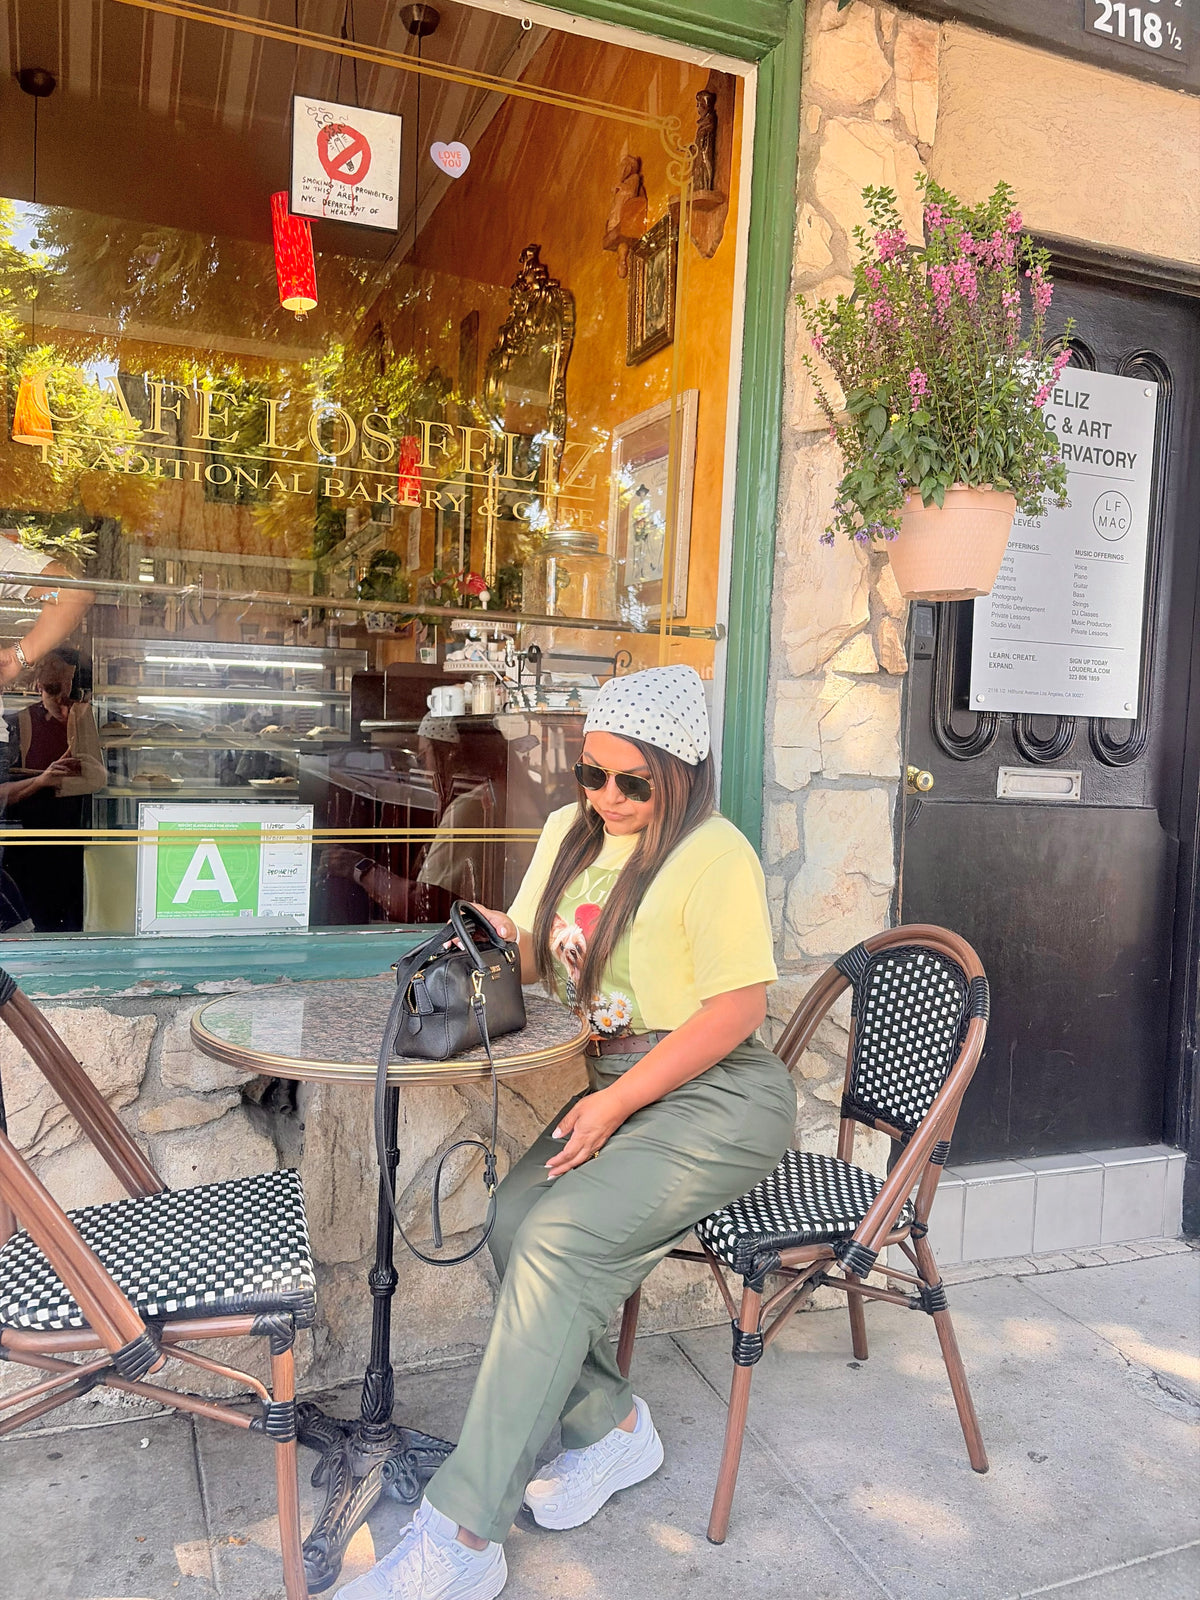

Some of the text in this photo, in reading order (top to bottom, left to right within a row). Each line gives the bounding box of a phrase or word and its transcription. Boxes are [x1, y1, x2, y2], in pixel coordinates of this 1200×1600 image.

[1093, 0, 1163, 48] 2118
[438, 150, 462, 160] LOVE
[442, 159, 462, 168] YOU
[302, 176, 394, 202] SMOKING IS PROHIBITED
[313, 186, 331, 195] THIS
[336, 191, 359, 202] AREA
[301, 194, 380, 215] NYC DEPARTMENT OF
[330, 207, 359, 217] HEALTH
[1050, 387, 1091, 410] ELIZ
[30, 366, 598, 491] CAFE LOS FELIZ
[1061, 416, 1073, 434] &
[1077, 419, 1113, 440] ART
[1059, 442, 1138, 470] RVATORY
[38, 443, 314, 496] TRADITIONAL
[323, 476, 470, 513] BAKERY
[476, 496, 503, 518] &
[1013, 518, 1042, 529] LEVELS
[1098, 515, 1127, 530] MAC
[1007, 541, 1040, 551] OFFERINGS
[1074, 549, 1125, 561] MUSIC OFFERINGS
[996, 574, 1017, 582] culpture
[1073, 572, 1088, 580] Piano
[1073, 581, 1089, 589] Guitar
[991, 592, 1023, 603] Photography
[1072, 590, 1085, 598] Bass
[992, 602, 1046, 613] Portfolio Development
[1072, 600, 1090, 608] Strings
[990, 611, 1031, 622] Private Lessons
[1071, 609, 1099, 618] DJ Classes
[990, 620, 1022, 630] Studio Visits
[1071, 618, 1112, 628] Music Production
[1070, 627, 1109, 637] Private Lessons
[989, 651, 1011, 660] LEARN.
[988, 661, 1014, 670] EXPAND.
[1069, 657, 1083, 665] SIGN
[1091, 659, 1109, 667] TODAY
[1069, 666, 1111, 675] LOUDERLA.COM
[172, 838, 239, 904] A
